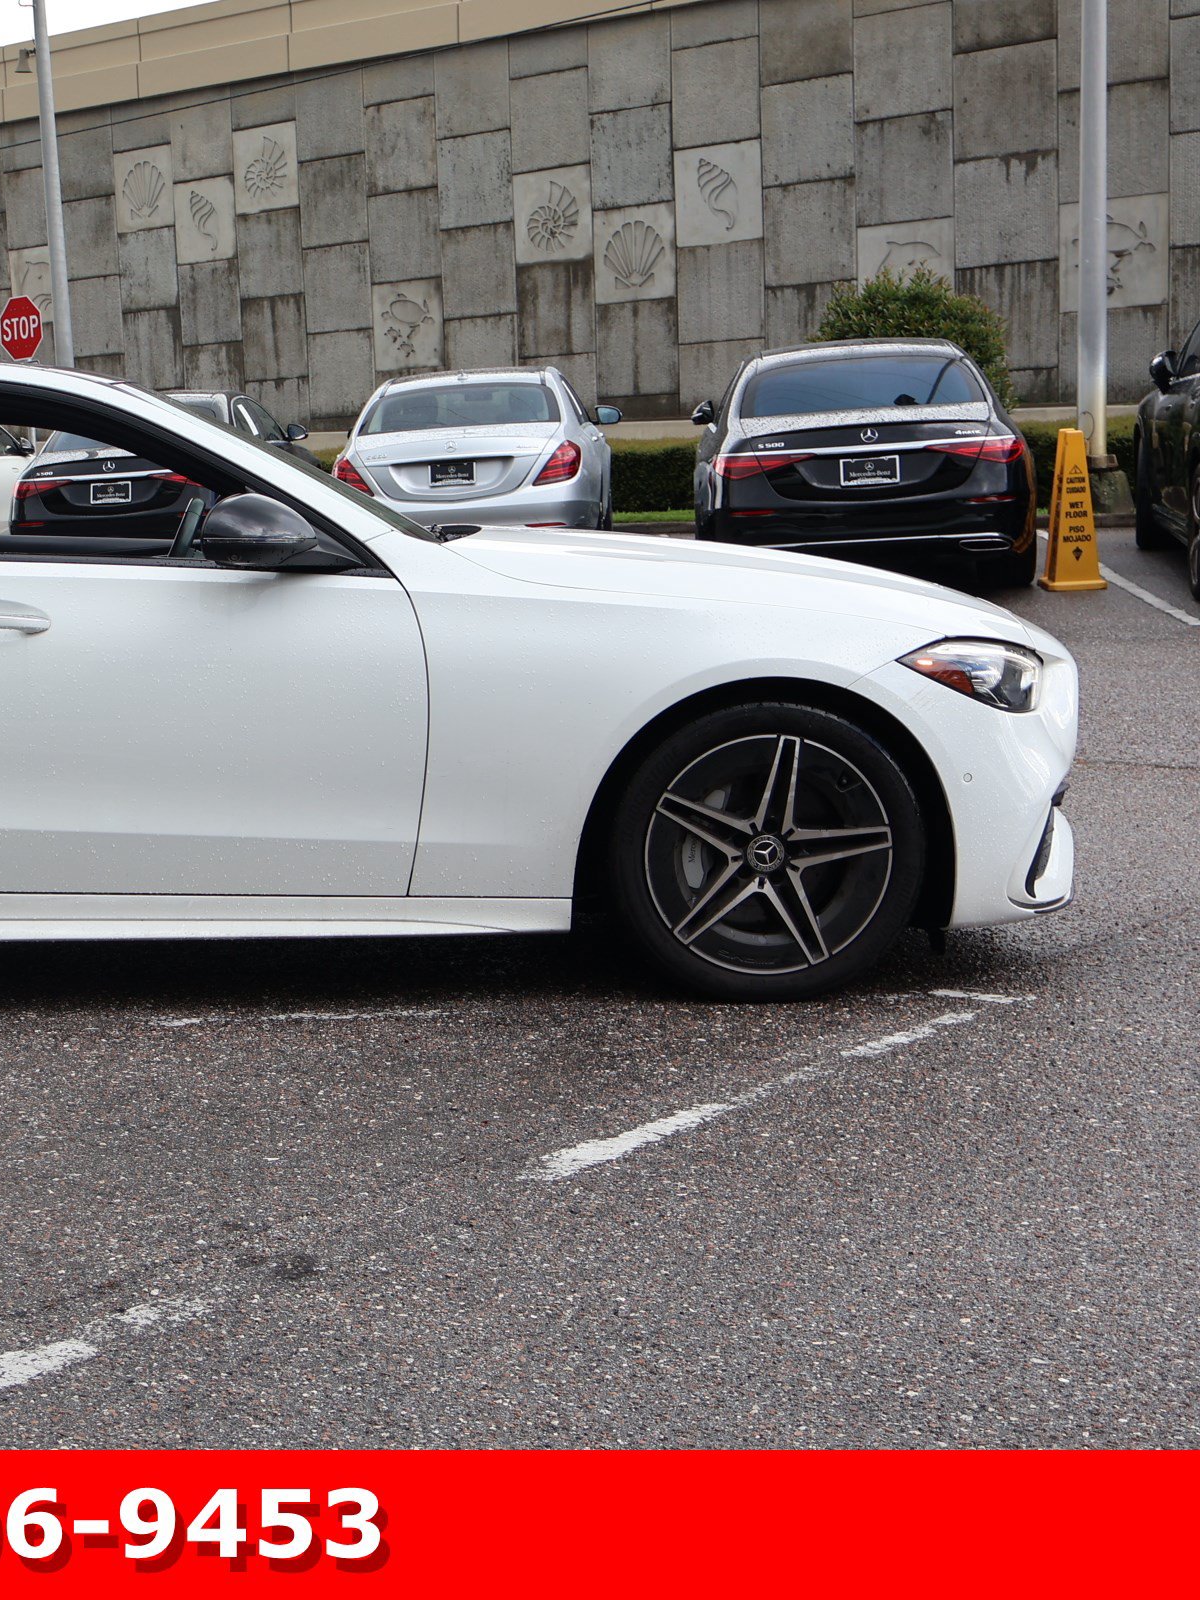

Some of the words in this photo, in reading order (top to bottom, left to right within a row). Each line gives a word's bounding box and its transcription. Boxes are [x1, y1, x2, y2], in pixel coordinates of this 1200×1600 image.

[3, 314, 39, 342] STOP
[849, 470, 891, 478] Mercedes-Benz
[1066, 476, 1085, 484] CAUTION
[1069, 501, 1083, 509] WET
[1065, 510, 1088, 519] FLOOR
[1069, 525, 1085, 533] PISO
[1063, 534, 1091, 543] MOJADO
